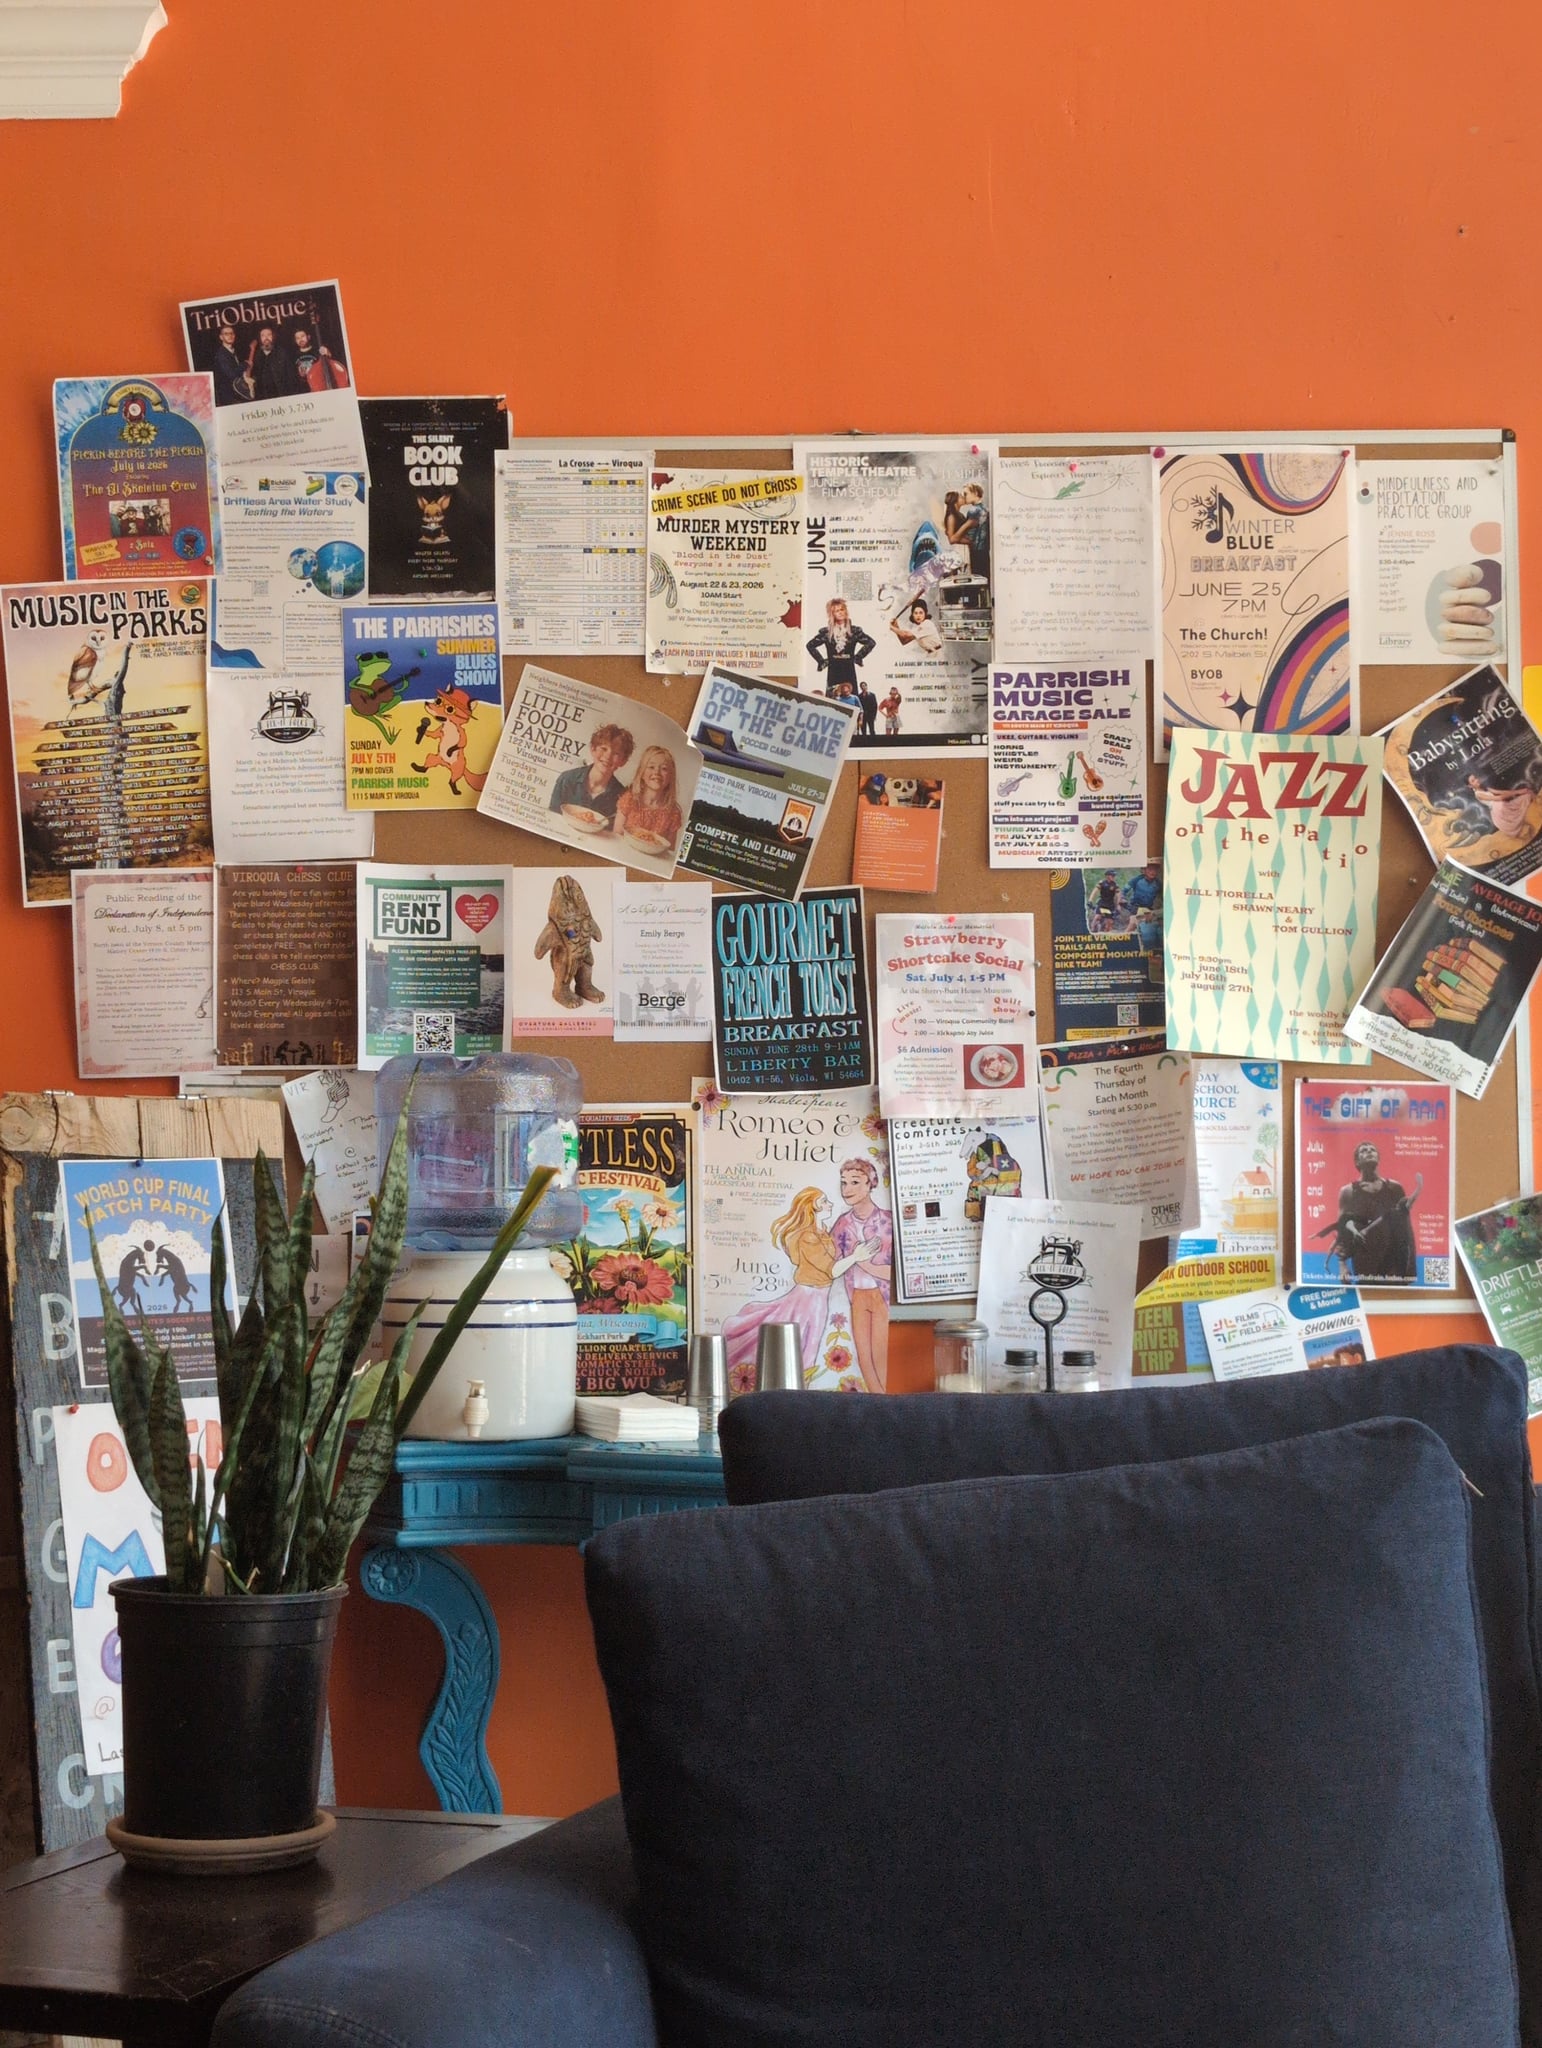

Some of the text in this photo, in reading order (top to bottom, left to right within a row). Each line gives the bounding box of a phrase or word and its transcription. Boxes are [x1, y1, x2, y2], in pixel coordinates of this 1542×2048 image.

[191, 300, 306, 331] TriOblique
[412, 435, 454, 443] THE SILENT
[404, 446, 463, 465] BOOK
[810, 457, 869, 467] HISTORIC
[559, 459, 643, 469] La Crosse Viroqua
[810, 467, 917, 477] TEMPLE THEATRE
[408, 467, 458, 486] CLUB
[1377, 477, 1478, 491] MINDFULNESS AND
[224, 497, 353, 507] Driftless Area Water Study
[651, 477, 798, 513] CRIME SCENE DO NOT CROSS
[1377, 491, 1446, 504] MEDITATION
[1377, 505, 1472, 519] PRACTICE GROUP
[656, 518, 800, 535] MURDER MYSTERY
[1227, 519, 1295, 534] WINTER
[690, 536, 767, 551] WEEKEND
[807, 516, 826, 576] JUNE
[1227, 535, 1274, 550] BLUE
[1191, 555, 1297, 572] BREAKFAST
[680, 580, 707, 589] August
[729, 581, 742, 589] 23,
[742, 581, 764, 589] 2026
[1179, 582, 1281, 597] JUNE 25
[10, 590, 169, 628] MUSIC IN THE
[1221, 600, 1266, 612] 7PM
[112, 608, 207, 639] PARKS
[353, 617, 387, 639] THE
[393, 615, 495, 638] PARRISHES
[1180, 628, 1267, 641] The Church!
[436, 639, 496, 655] SUMMER
[455, 654, 496, 670] BLUES
[454, 670, 496, 686] SHOW
[993, 670, 1130, 688] PARRISH
[1191, 669, 1223, 679] BYOB
[993, 690, 1093, 706] MUSIC
[522, 690, 585, 723] LITTLE
[709, 681, 846, 740] FOR THE LOVE
[993, 708, 1131, 721] GARAGE SALE
[516, 705, 568, 734] FOOD
[703, 701, 840, 758] OF THE GAME
[1408, 697, 1515, 771] Babysitting
[351, 741, 382, 750] SUNDAY
[511, 720, 587, 757] PANTRY
[351, 753, 396, 764] JULY 5TH
[516, 747, 547, 764] Viroqua
[1445, 760, 1458, 771] by
[1462, 735, 1493, 762] Lola
[351, 777, 430, 789] PARRISH MUSIC
[1180, 747, 1368, 819] JAZZ
[695, 823, 796, 862] COMPETE, AND LEARN!
[1176, 822, 1368, 868] on the patio
[233, 872, 352, 882] VIROQUA CHESS CLUB
[1259, 870, 1280, 879] with
[382, 893, 441, 902] COMMUNITY
[1185, 888, 1274, 900] BILL FIORELLA
[382, 903, 441, 918] RENT
[1232, 903, 1315, 915] SHAWN NEARY
[382, 919, 441, 934] FUND
[640, 929, 685, 939] Emily Berge
[716, 898, 857, 966] GOURMET
[1273, 925, 1353, 936] TOM GULLION
[903, 932, 1008, 949] Strawberry
[888, 952, 1024, 972] Shortcake Social
[1055, 952, 1105, 960] COMPOSITE
[906, 973, 1005, 983] Sat. July 4, 1-5 PM
[721, 961, 856, 1021] FRENCH TOAST
[638, 993, 685, 1010] Berge
[724, 1020, 862, 1042] BREAKFAST
[724, 1041, 861, 1056] SUNDAY JUNE 28th 9-11AM
[726, 1055, 861, 1072] LIBERTY BAR
[1094, 1063, 1144, 1076] The Fourth
[1094, 1076, 1147, 1090] Thursday of
[1096, 1090, 1148, 1104] Each Month
[1304, 1097, 1446, 1120] THE GIFT OF RAIN
[719, 1109, 860, 1137] Romeo &
[894, 1118, 961, 1129] creature
[895, 1127, 966, 1140] comforts
[755, 1138, 844, 1163] Juliet
[589, 1171, 661, 1192] FESTIVAL
[74, 1177, 211, 1207] WORLD CUP FINAL
[77, 1197, 213, 1230] WATCH PARTY
[1152, 1201, 1180, 1214] OTHER
[732, 1257, 780, 1275] June
[1178, 1260, 1270, 1278] OUTDOOR SCHOOL
[600, 1318, 648, 1330] Wisconsin
[1137, 1307, 1173, 1329] TEEN
[1235, 1312, 1260, 1324] FILMS
[1304, 1315, 1355, 1335] SHOWING
[1133, 1328, 1178, 1348] RIVER
[1239, 1326, 1261, 1336] FIELD
[1138, 1351, 1175, 1372] TRIP
